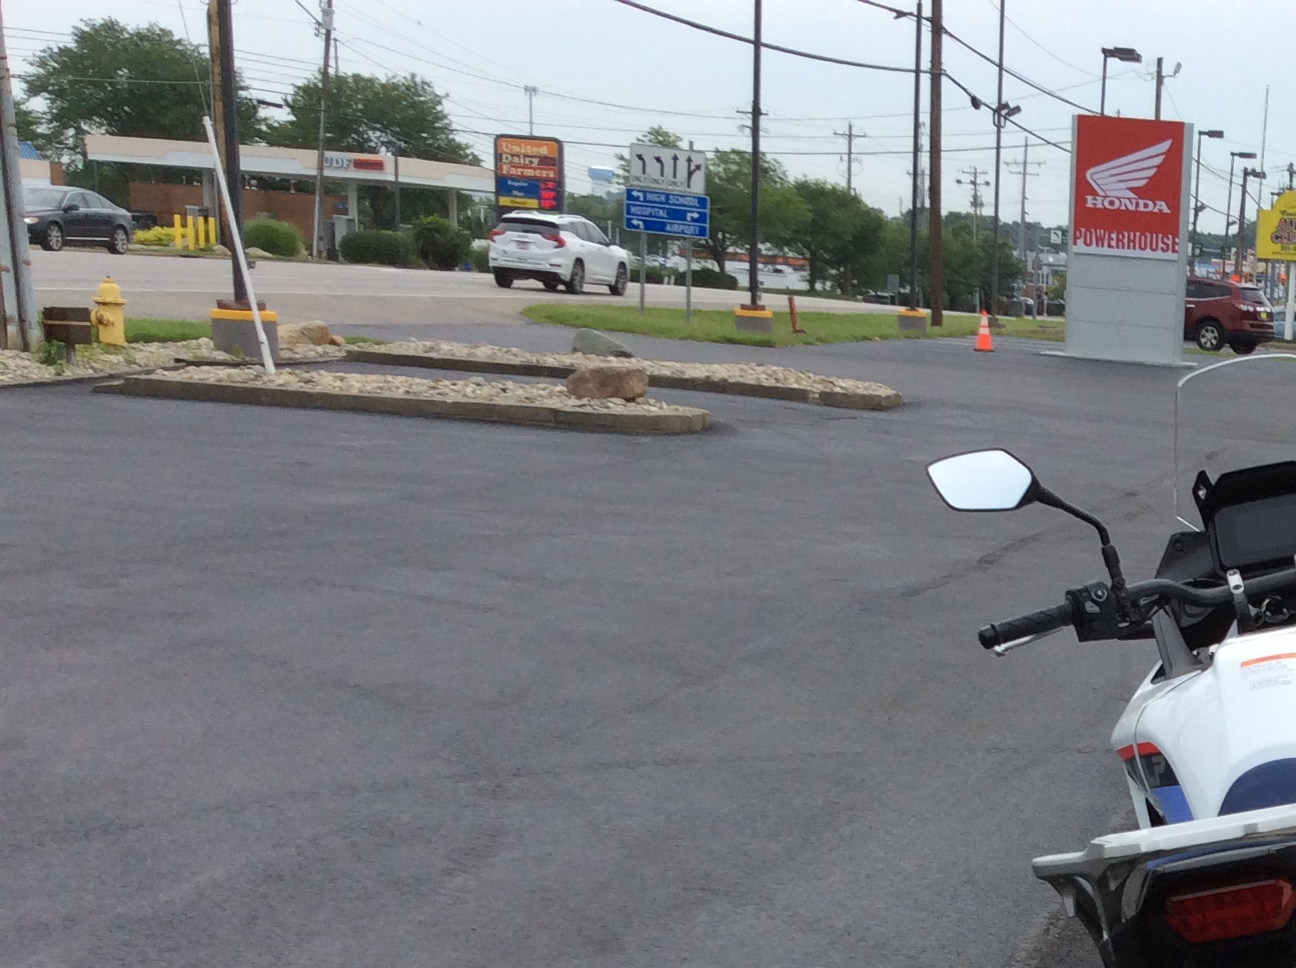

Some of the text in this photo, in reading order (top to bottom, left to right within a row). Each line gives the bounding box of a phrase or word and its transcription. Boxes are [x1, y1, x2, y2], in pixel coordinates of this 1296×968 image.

[502, 142, 548, 155] United
[324, 156, 351, 168] UDF
[502, 153, 540, 166] Dairy
[501, 164, 555, 178] Farmers
[646, 192, 700, 207] HIGH SCHOOL
[1085, 195, 1171, 214] HONDA
[629, 205, 669, 218] HOSPITAL
[665, 223, 700, 235] AIRPORT
[1072, 228, 1179, 254] POWERHOUSE
